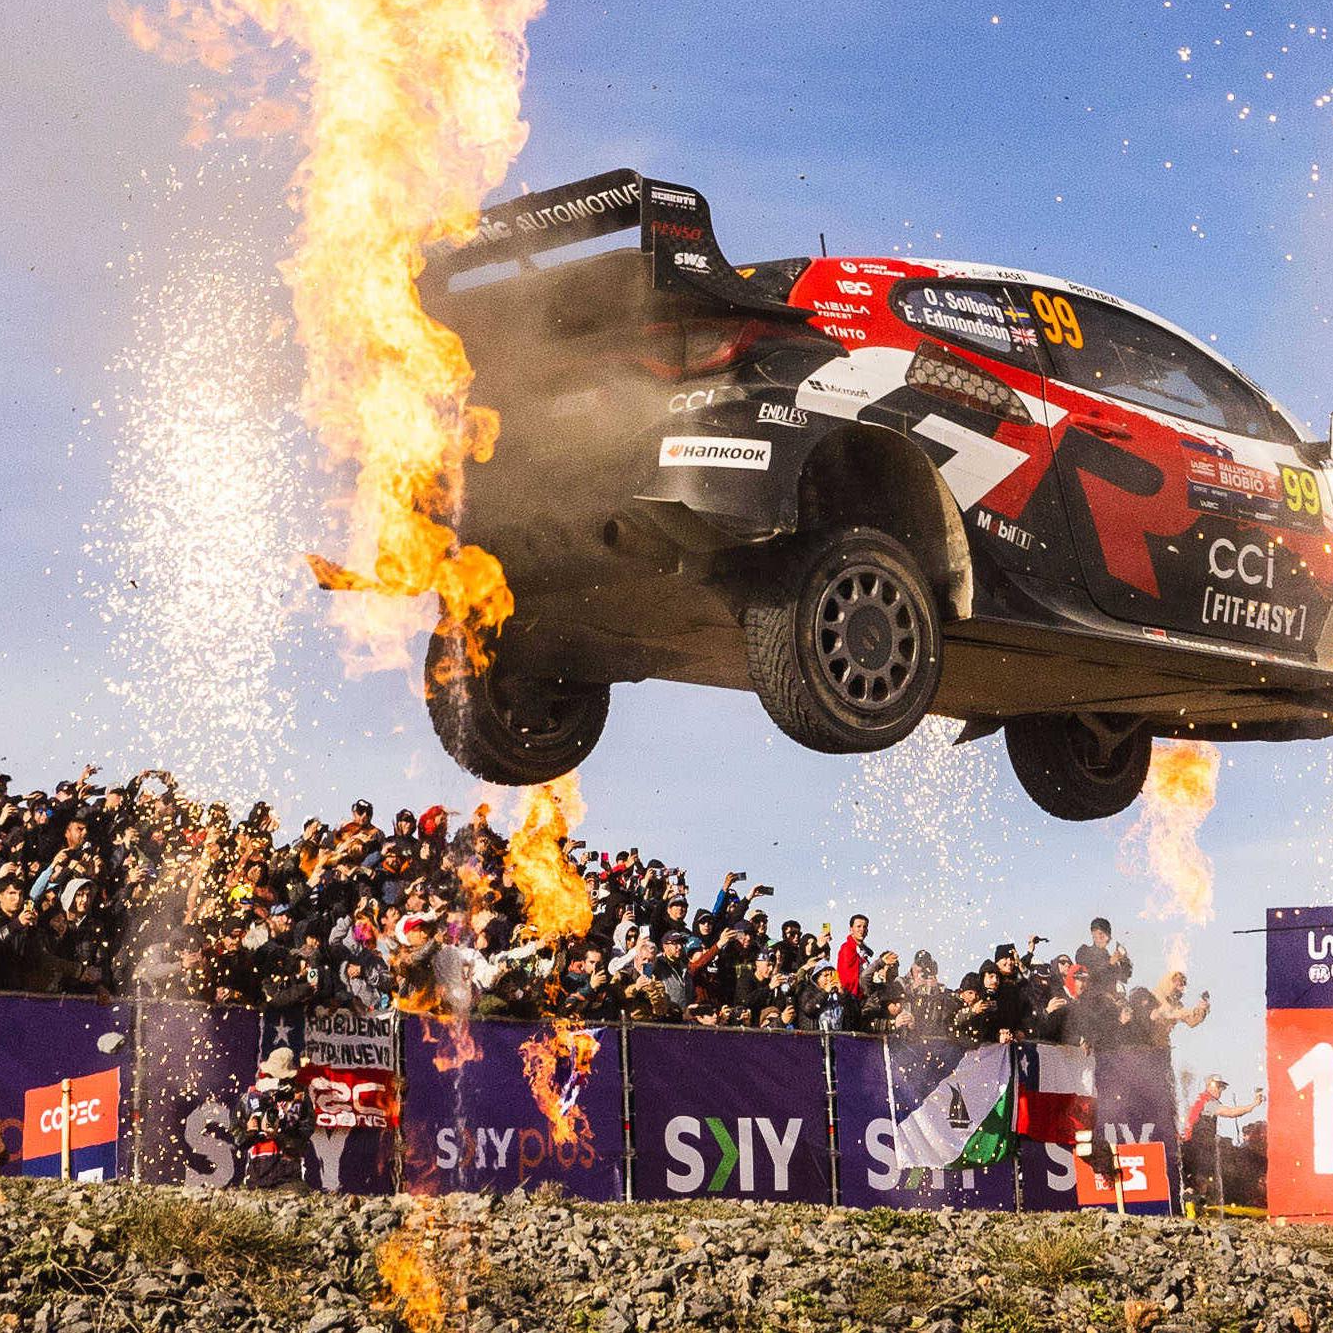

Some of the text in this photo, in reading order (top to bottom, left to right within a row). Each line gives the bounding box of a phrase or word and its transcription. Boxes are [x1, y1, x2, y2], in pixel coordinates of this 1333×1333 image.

[516, 183, 641, 234] AUTOMOTIVE
[651, 220, 703, 240] DENSO
[903, 304, 1011, 342] E. Edmondson
[923, 287, 1005, 324] O. Solberg
[1031, 290, 1084, 350] 99
[823, 324, 866, 340] KINTO
[758, 402, 809, 426] ENDLESS
[1281, 467, 1321, 516] 99
[976, 509, 1017, 544] Mobil
[666, 1115, 803, 1193] SKY
